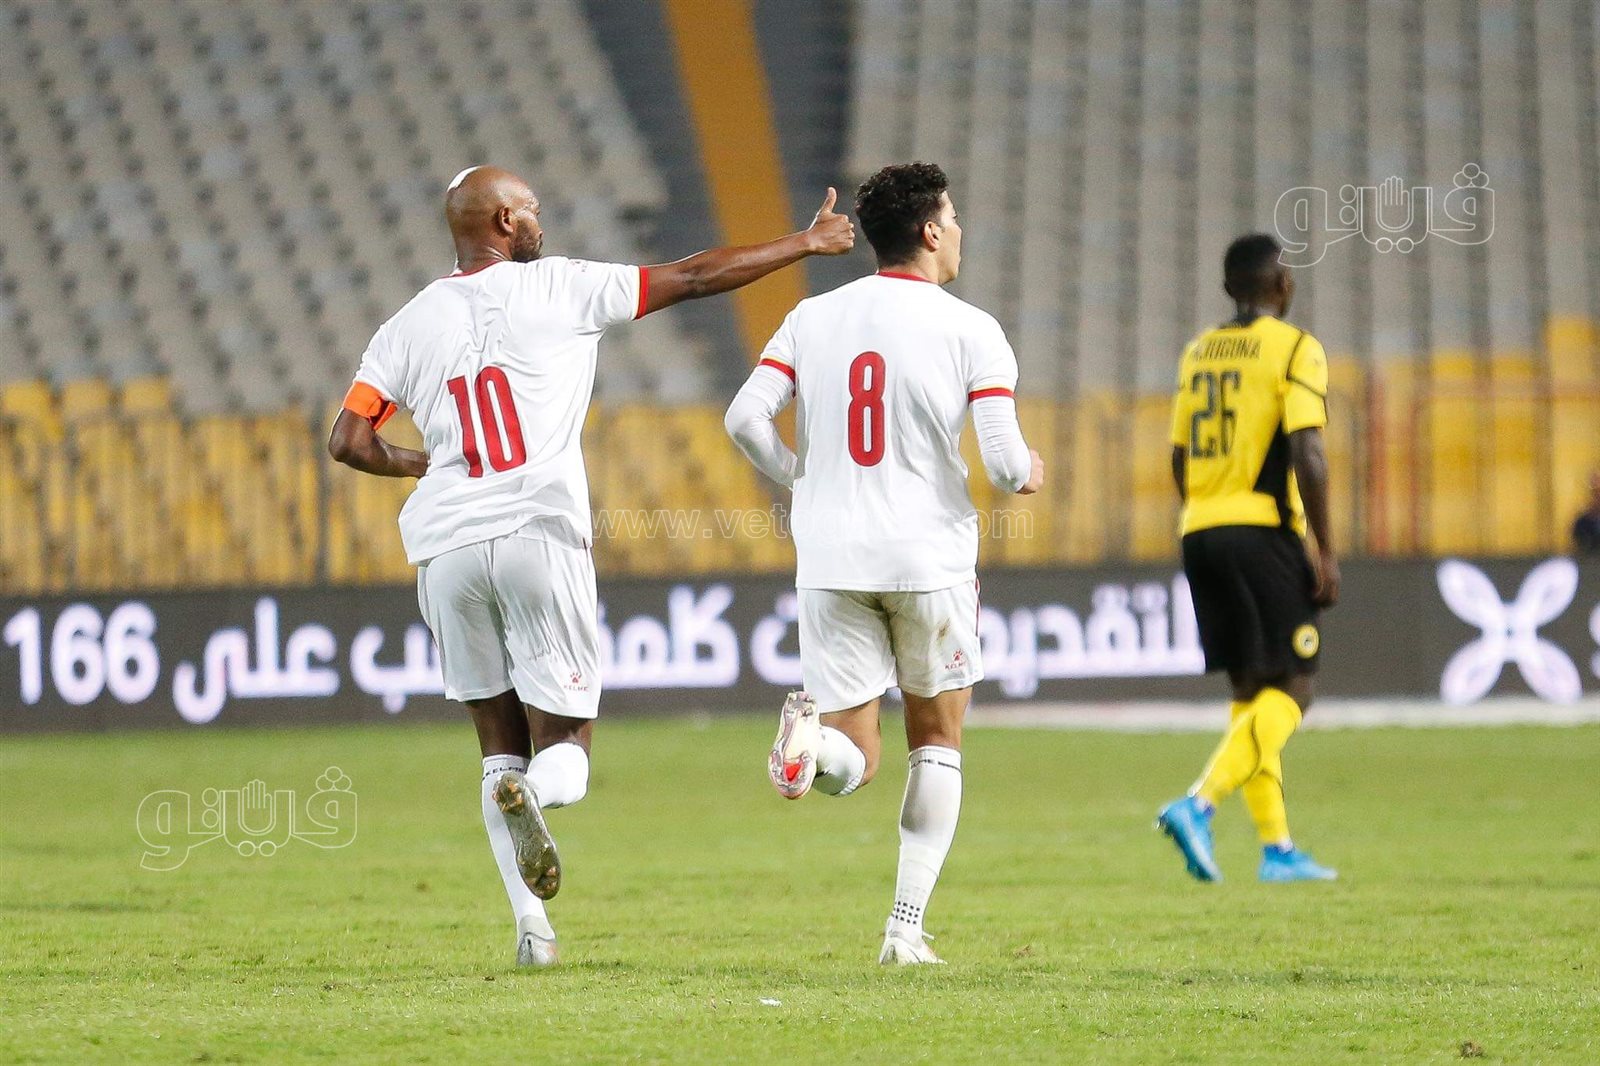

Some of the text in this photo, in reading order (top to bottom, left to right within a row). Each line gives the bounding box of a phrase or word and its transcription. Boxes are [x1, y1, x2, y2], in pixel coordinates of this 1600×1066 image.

[447, 366, 527, 478] 10
[848, 351, 886, 467] 8
[1190, 370, 1241, 458] 26
[3, 600, 161, 706] 166
[172, 597, 341, 724] على
